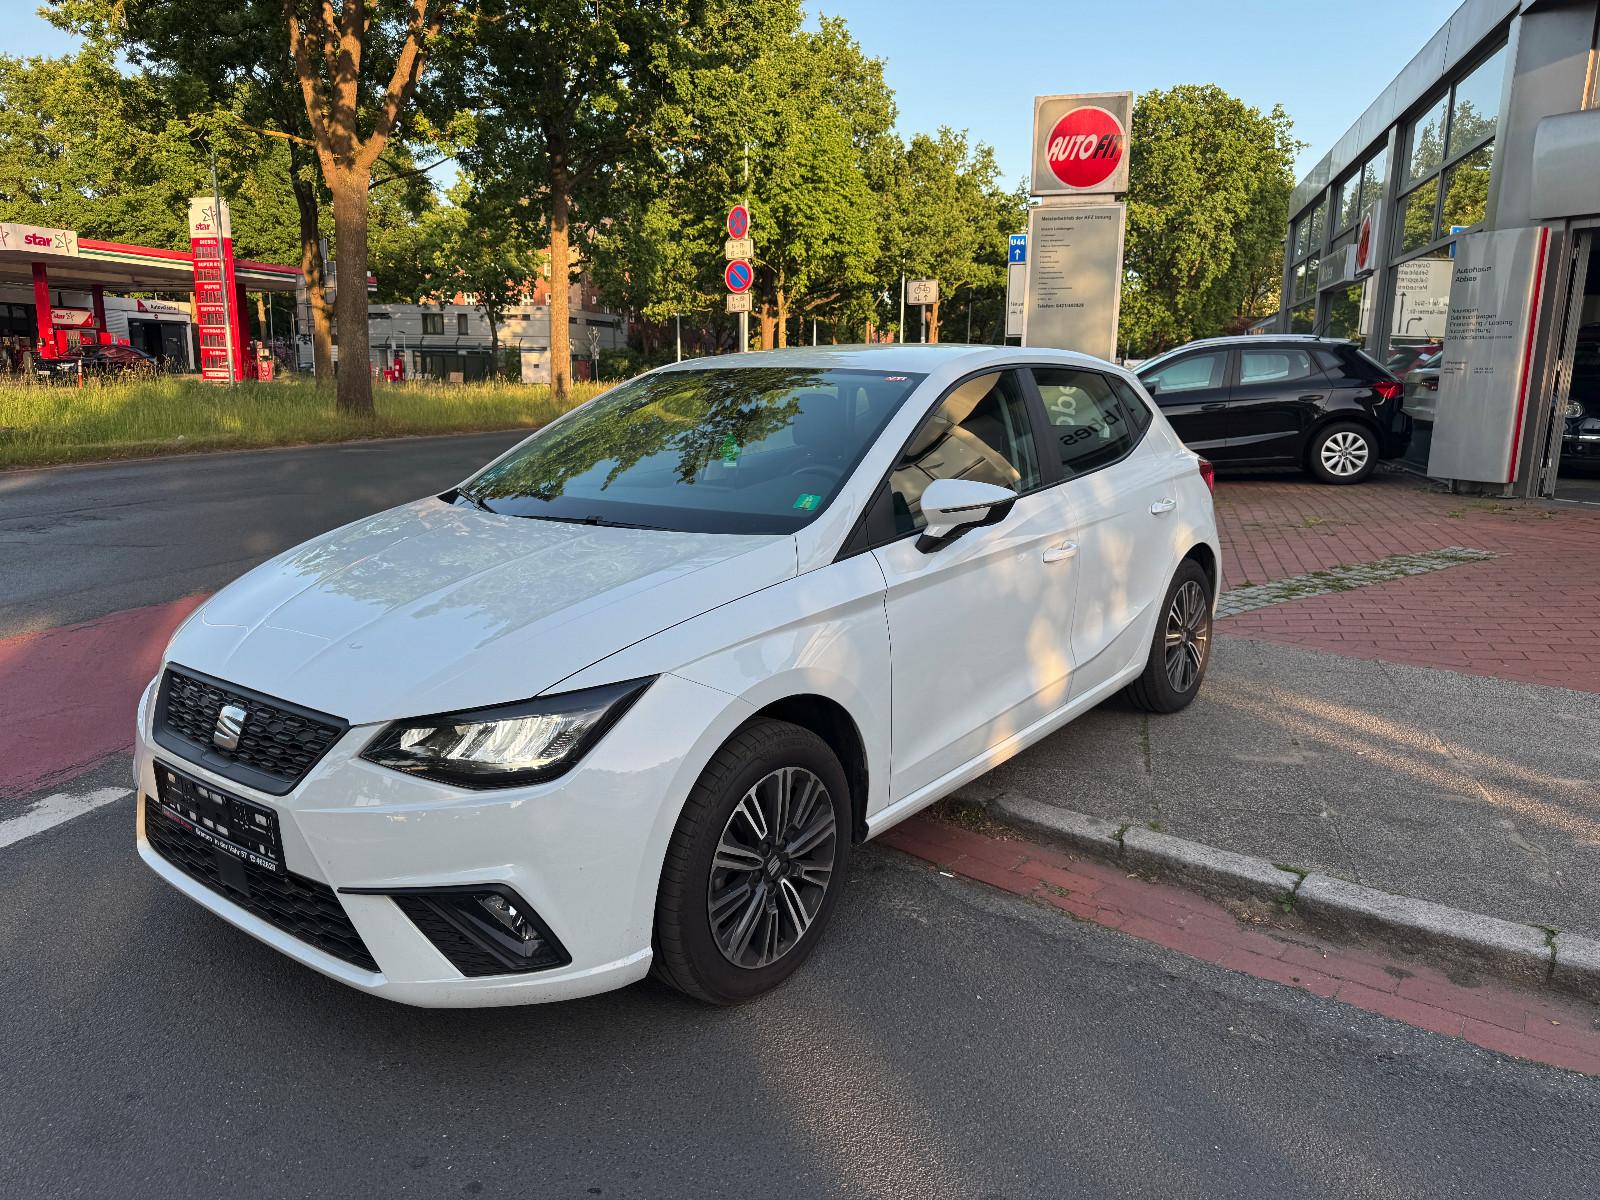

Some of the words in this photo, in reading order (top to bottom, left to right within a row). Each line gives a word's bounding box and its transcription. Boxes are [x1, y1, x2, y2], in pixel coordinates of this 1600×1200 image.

[1047, 134, 1122, 162] AUTOFIT
[195, 222, 210, 230] star
[24, 232, 52, 248] star
[1010, 238, 1026, 246] U44
